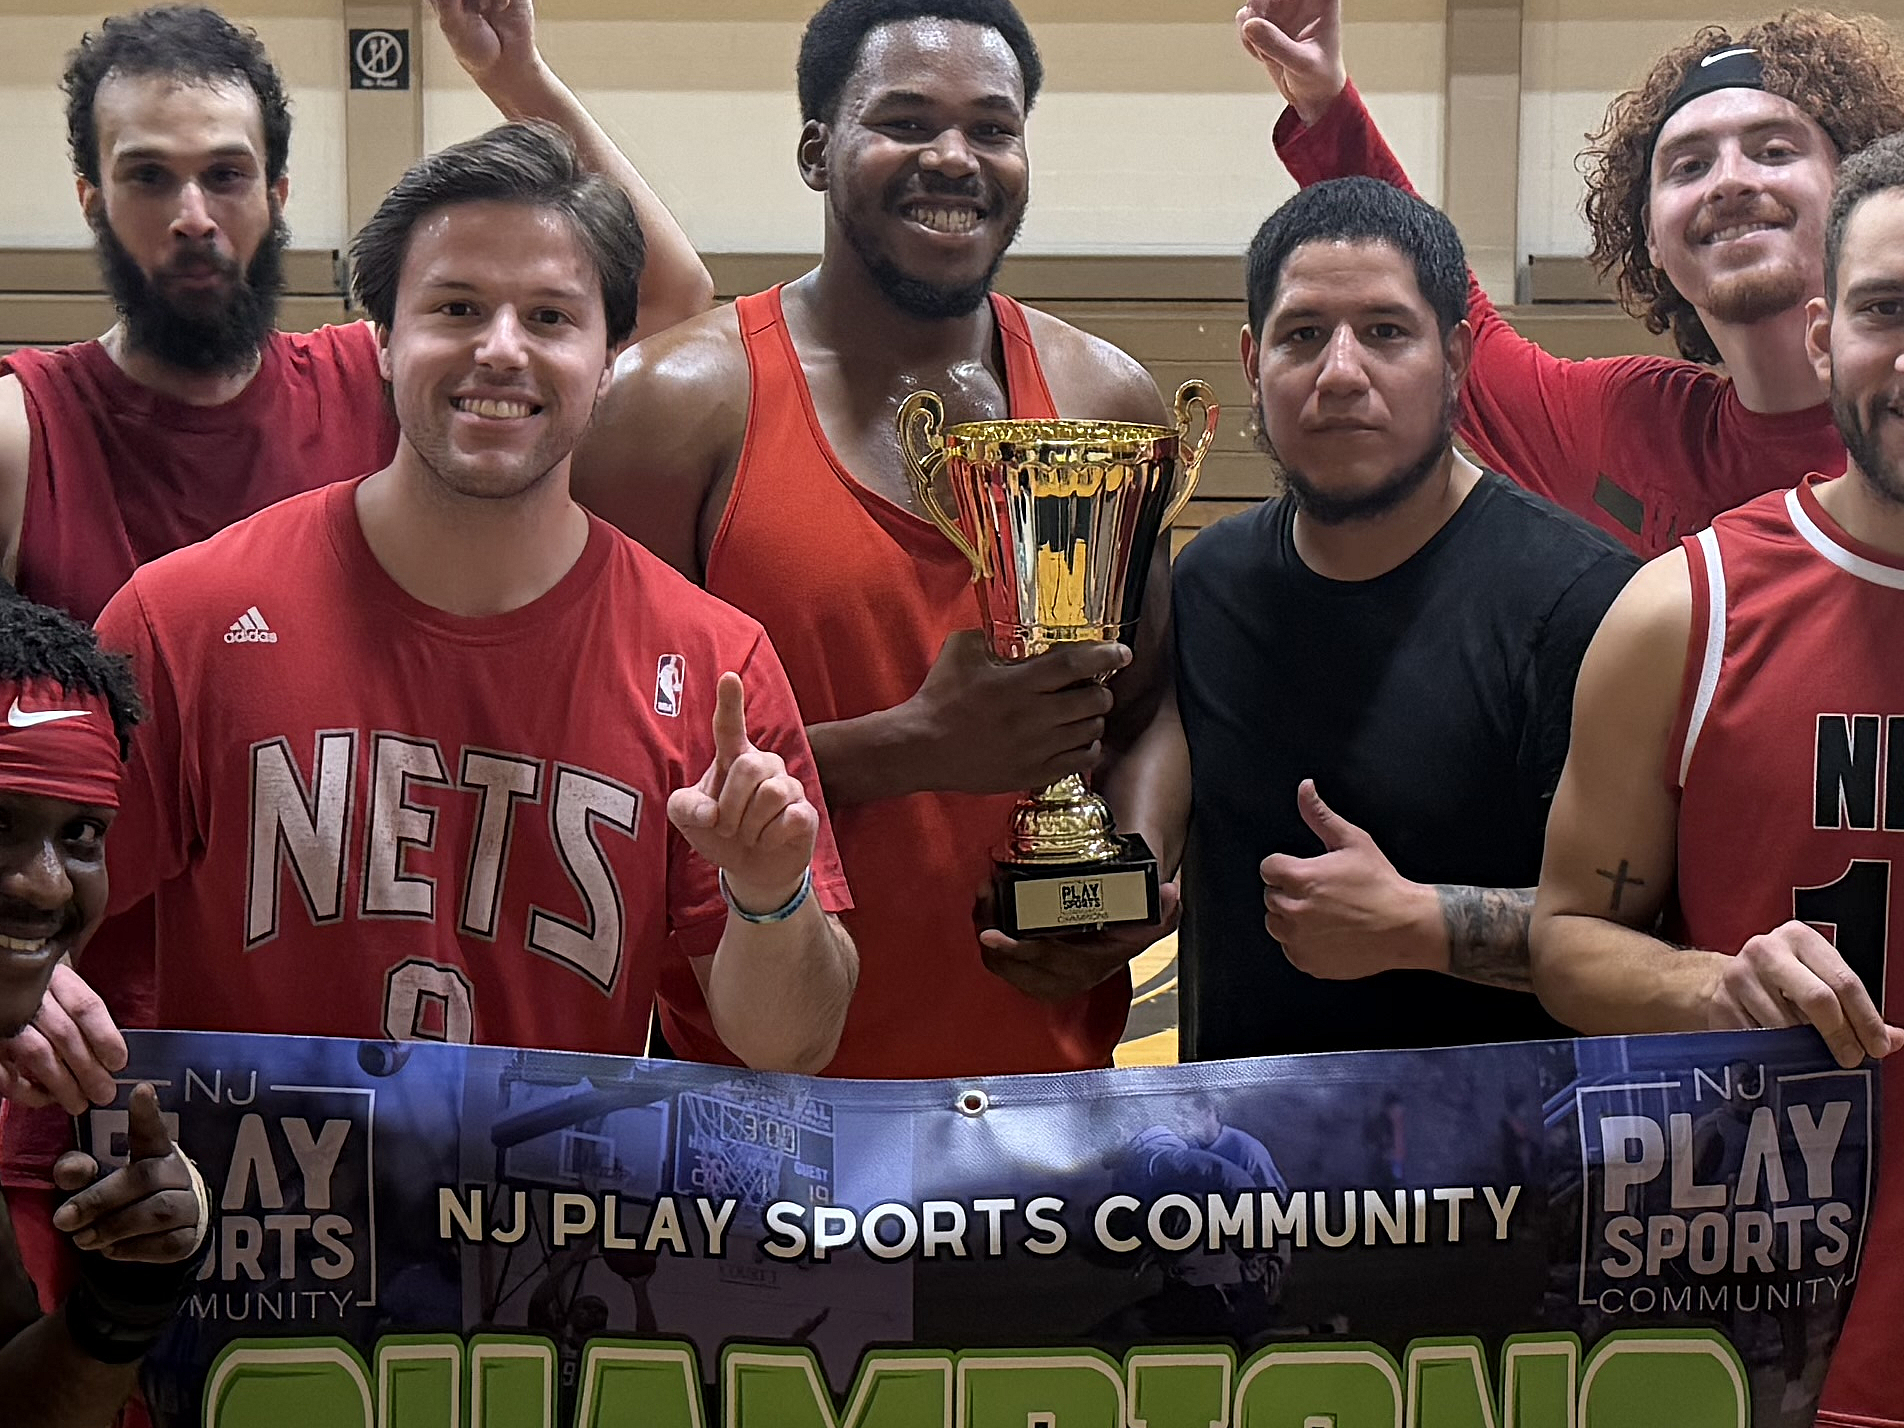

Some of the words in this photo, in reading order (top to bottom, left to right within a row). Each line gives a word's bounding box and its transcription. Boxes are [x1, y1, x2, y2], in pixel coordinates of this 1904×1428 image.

[244, 728, 643, 997] NETS
[1061, 882, 1100, 901] PLAY
[185, 1068, 257, 1105] NJ
[1693, 1064, 1765, 1101] NJ
[1600, 1101, 1852, 1212] PLAY
[439, 1188, 526, 1243] NJ
[553, 1193, 736, 1254] PLAY
[764, 1197, 1067, 1260] SPORTS
[1095, 1185, 1522, 1253] COMMUNITY
[1601, 1202, 1852, 1278] SPORTS
[1600, 1273, 1846, 1314] COMMUNITY
